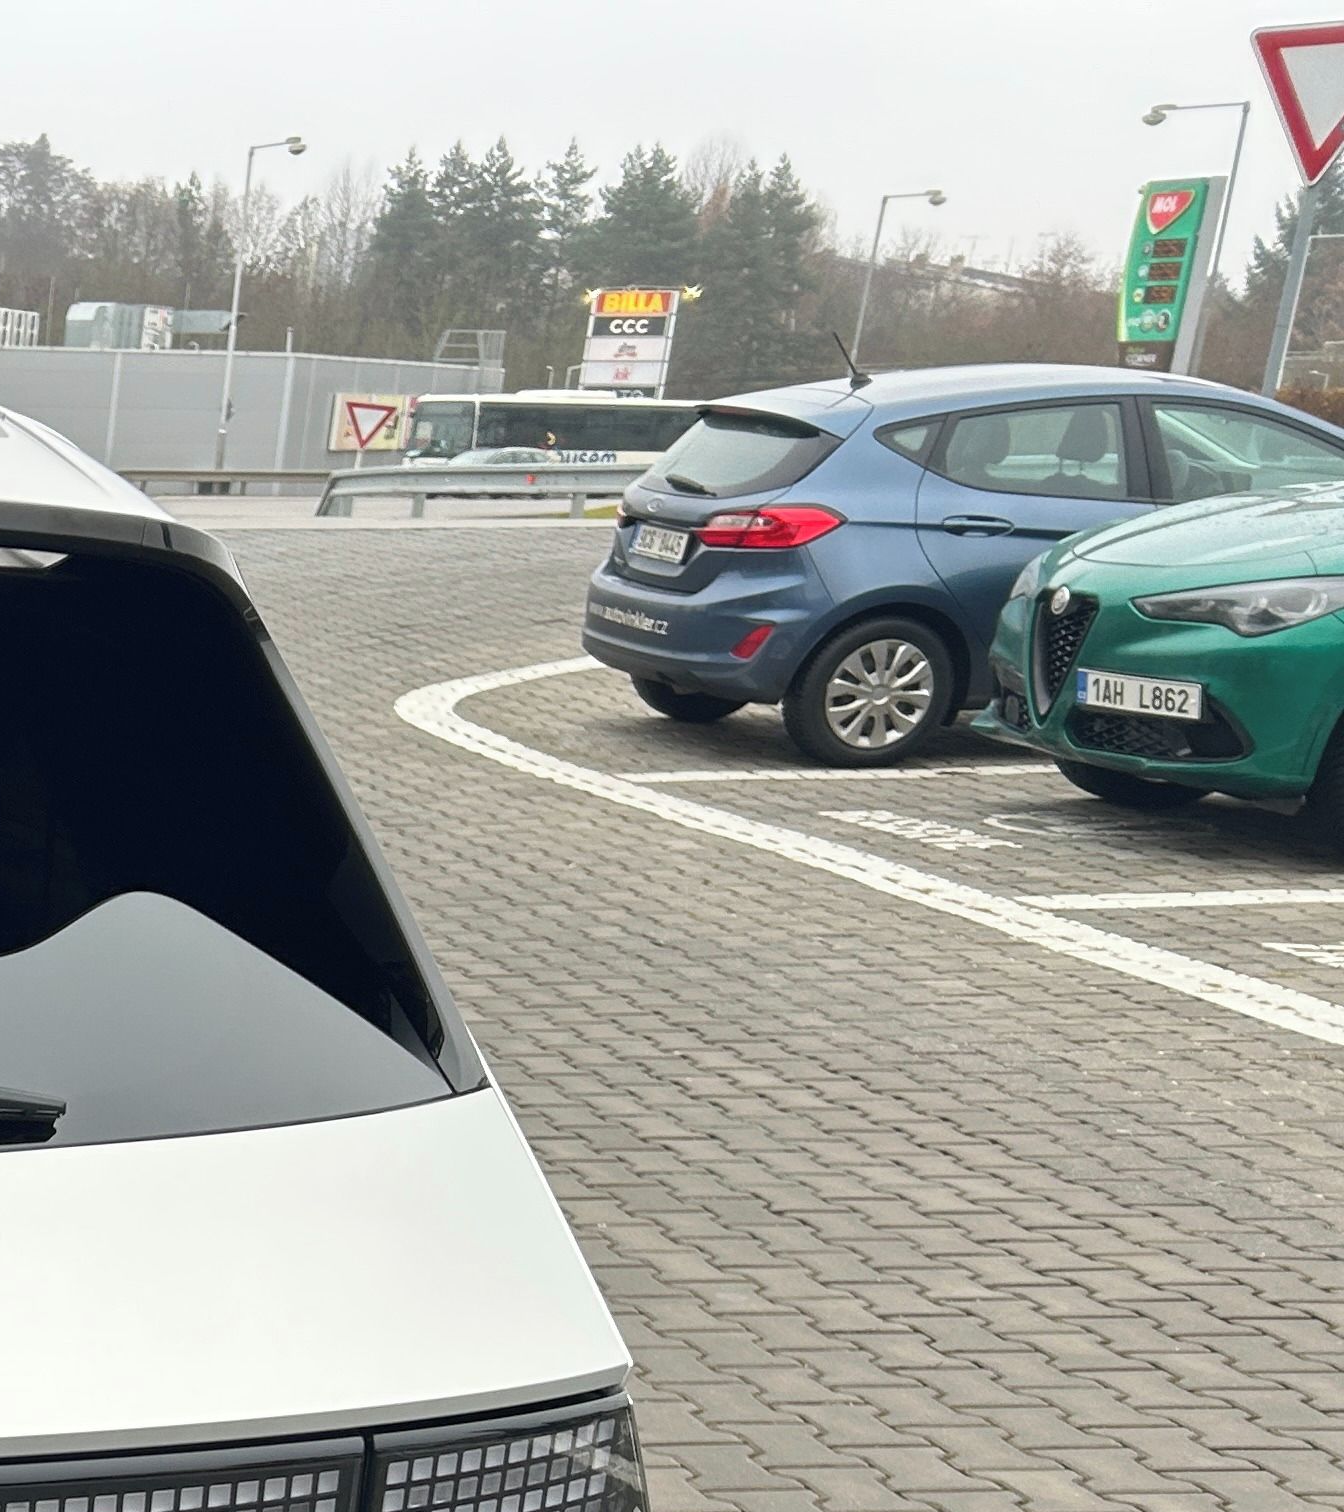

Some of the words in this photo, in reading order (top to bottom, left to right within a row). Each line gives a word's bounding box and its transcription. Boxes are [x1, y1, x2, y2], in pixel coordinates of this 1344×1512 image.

[1152, 196, 1179, 214] MOL
[602, 292, 663, 314] BILLA
[609, 318, 649, 335] CCC
[1092, 678, 1124, 705] 1AH
[1139, 684, 1189, 713] L862
